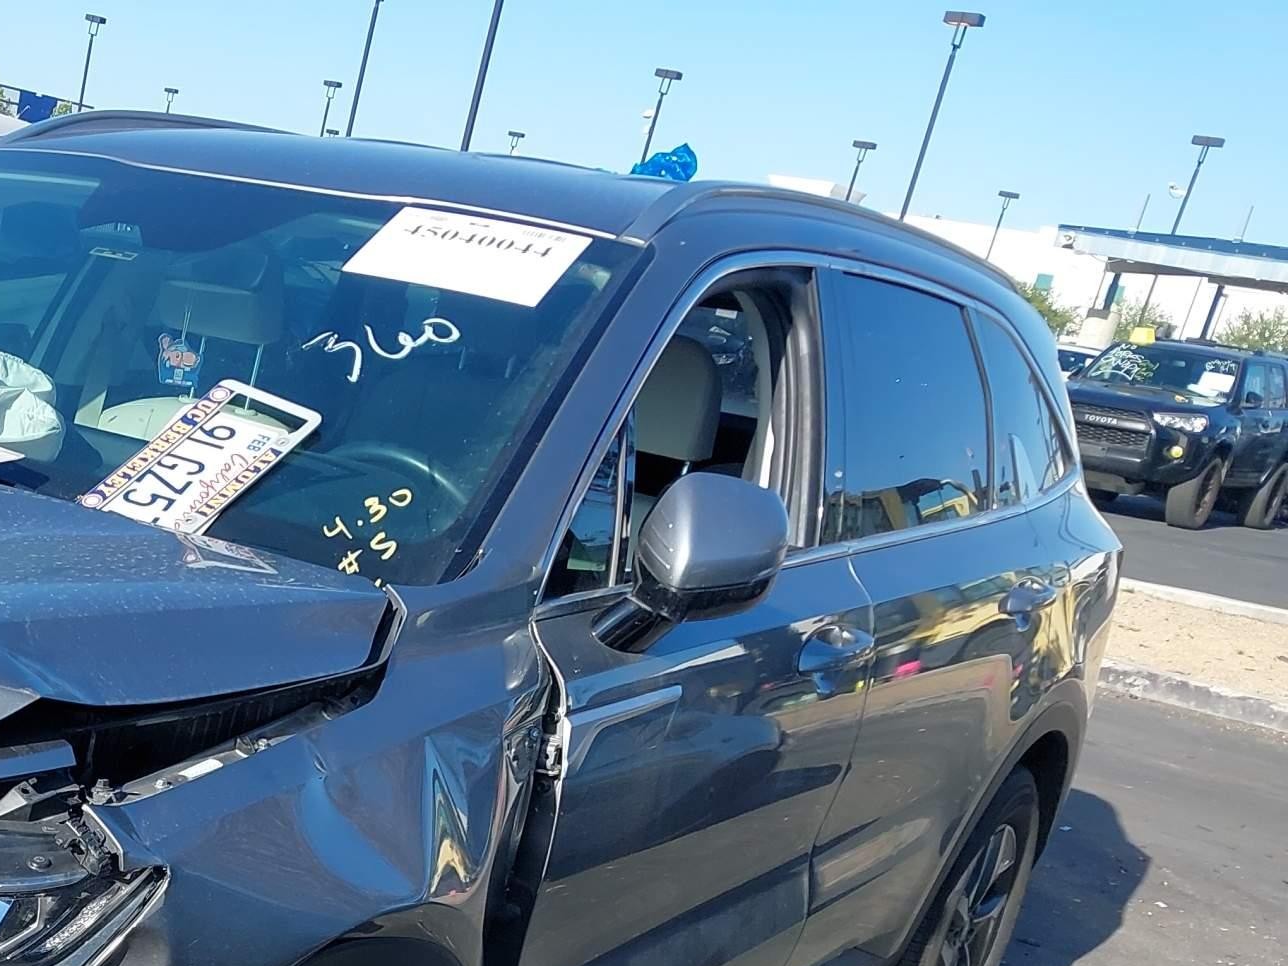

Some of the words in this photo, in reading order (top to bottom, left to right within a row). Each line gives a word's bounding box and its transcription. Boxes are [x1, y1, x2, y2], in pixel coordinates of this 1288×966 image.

[404, 224, 553, 257] 45040044
[301, 317, 461, 383] 360
[186, 402, 214, 422] UC
[1084, 414, 1118, 425] TOYOTA
[103, 423, 190, 496] BERKELEY
[246, 433, 271, 452] FEB
[173, 452, 248, 531] California
[197, 448, 280, 517] ALUMNI
[323, 488, 412, 540] 4.30
